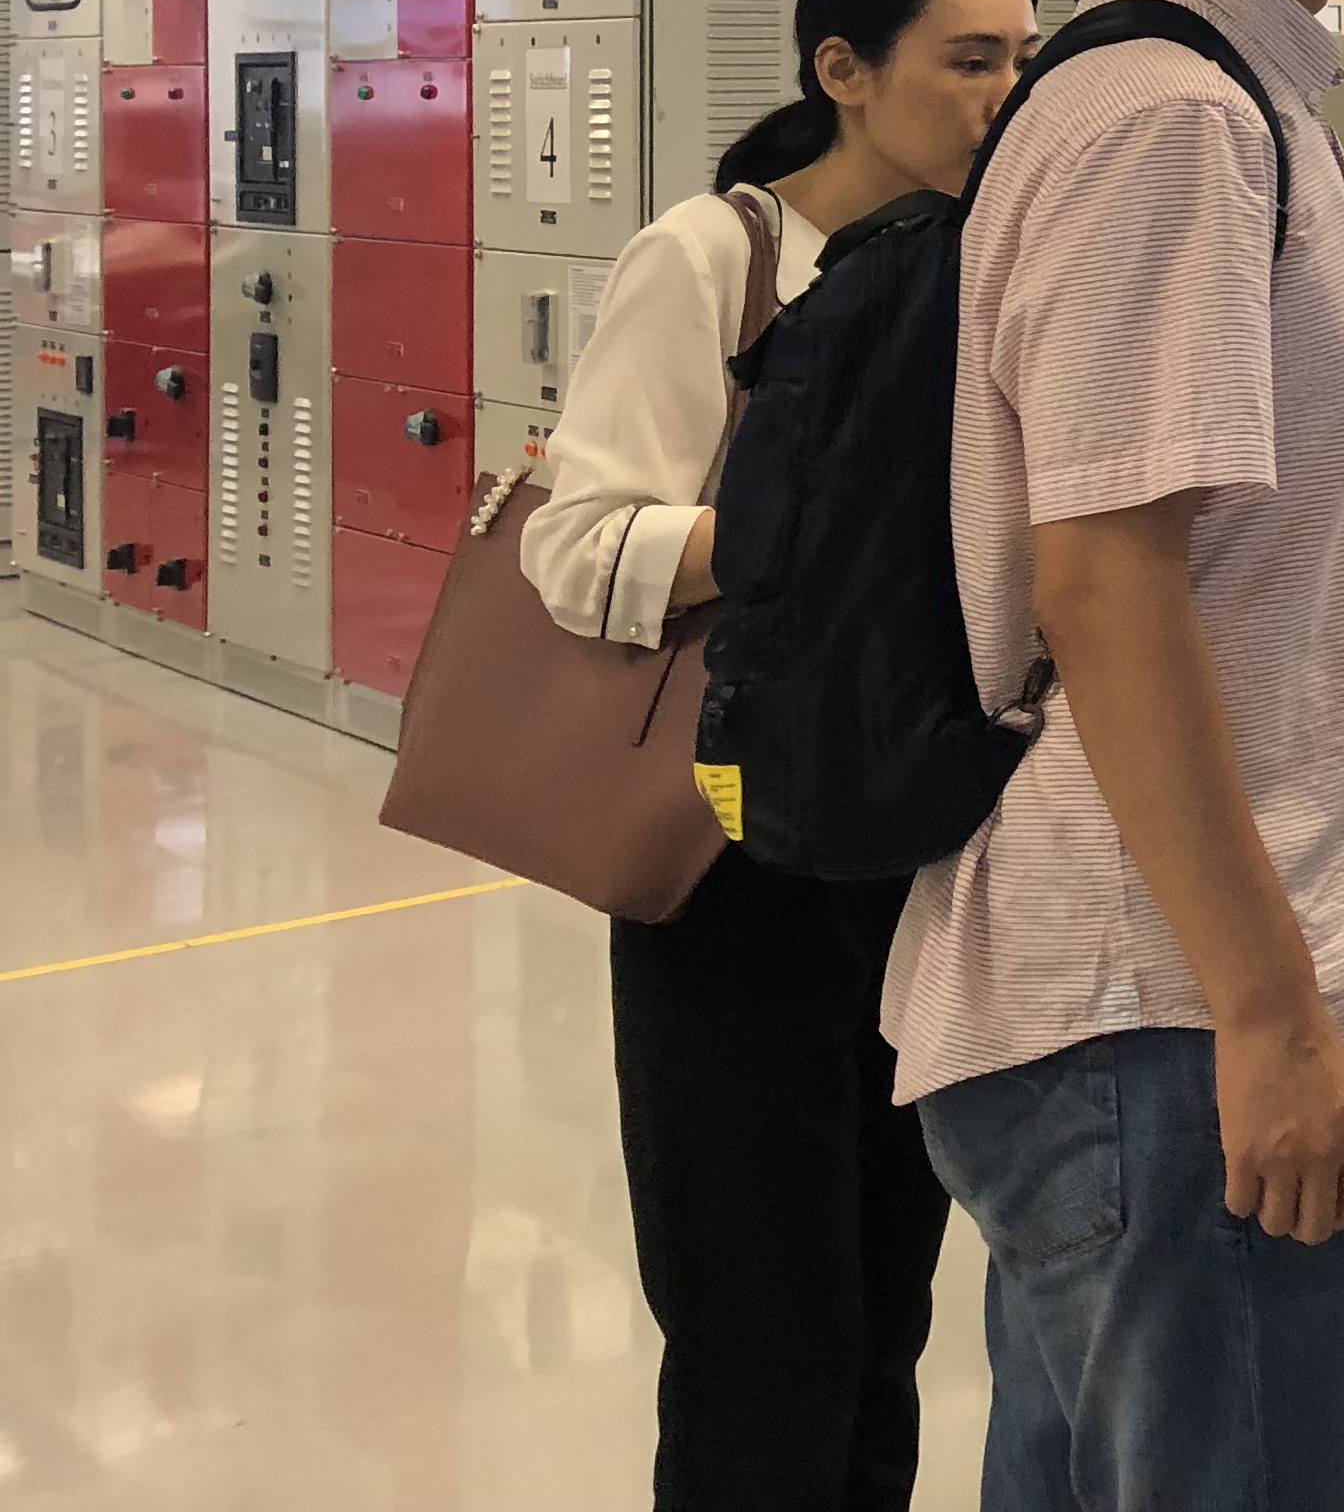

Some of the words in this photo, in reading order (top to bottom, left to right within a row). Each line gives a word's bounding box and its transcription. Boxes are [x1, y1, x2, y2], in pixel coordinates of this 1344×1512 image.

[529, 72, 567, 87] Switchboard
[47, 110, 57, 157] 3
[540, 116, 557, 178] 4
